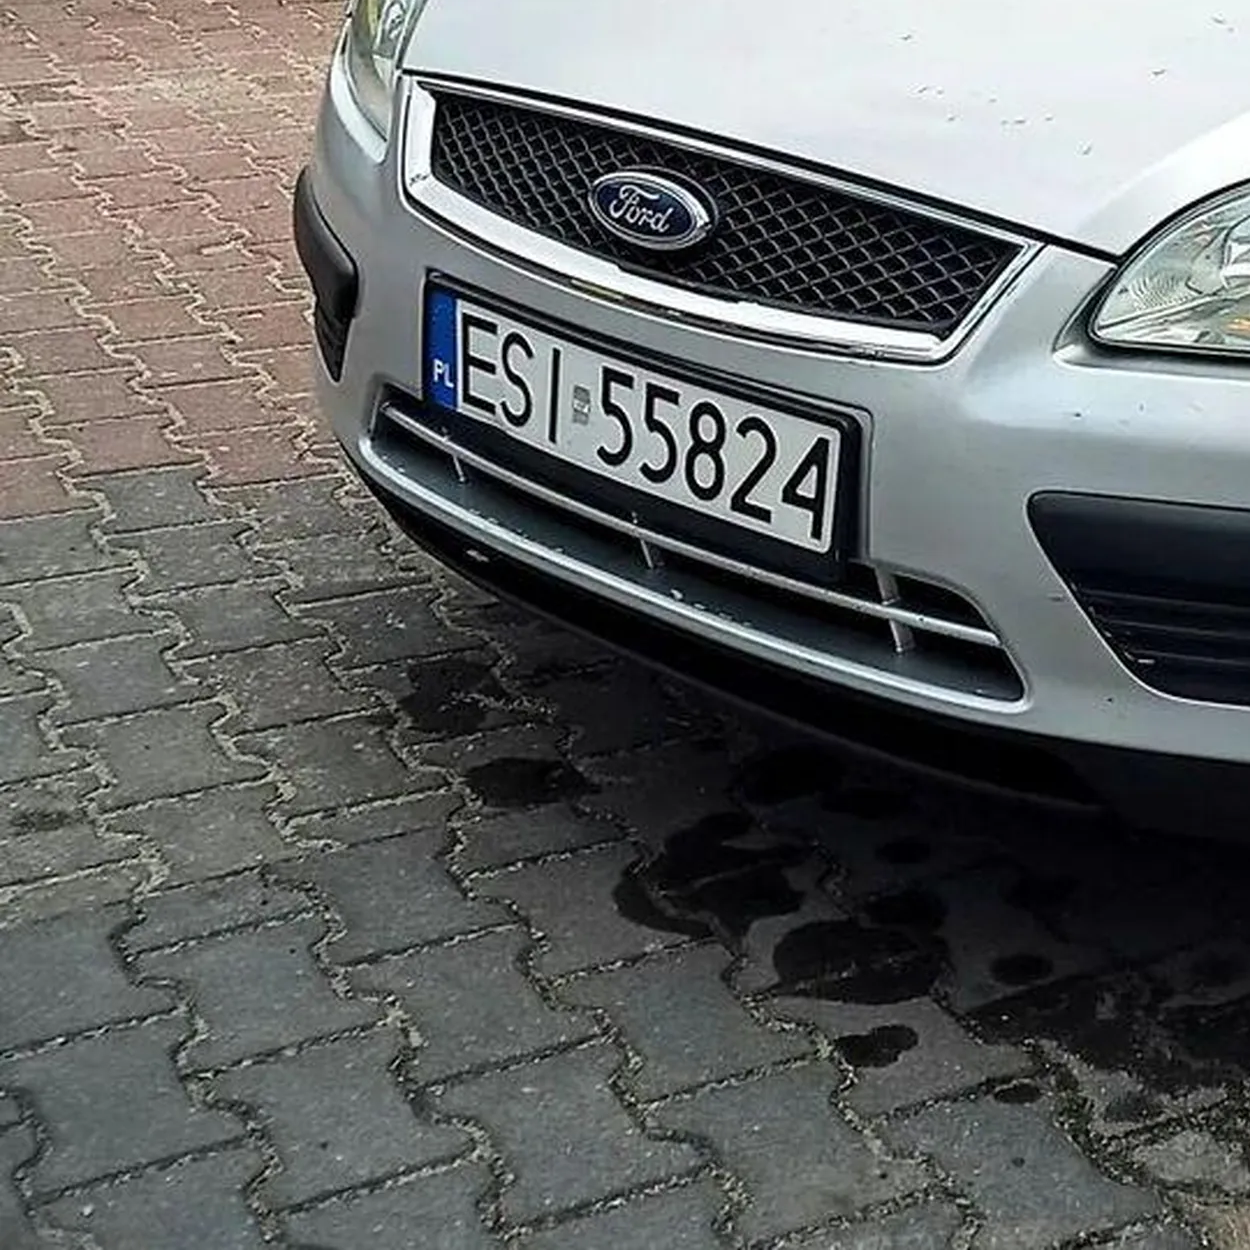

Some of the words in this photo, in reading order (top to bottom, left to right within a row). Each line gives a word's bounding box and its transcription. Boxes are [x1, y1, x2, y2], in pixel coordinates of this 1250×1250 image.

[609, 185, 673, 232] Ford
[433, 358, 454, 388] PL
[461, 313, 561, 444] ESI
[597, 366, 830, 540] 55824
